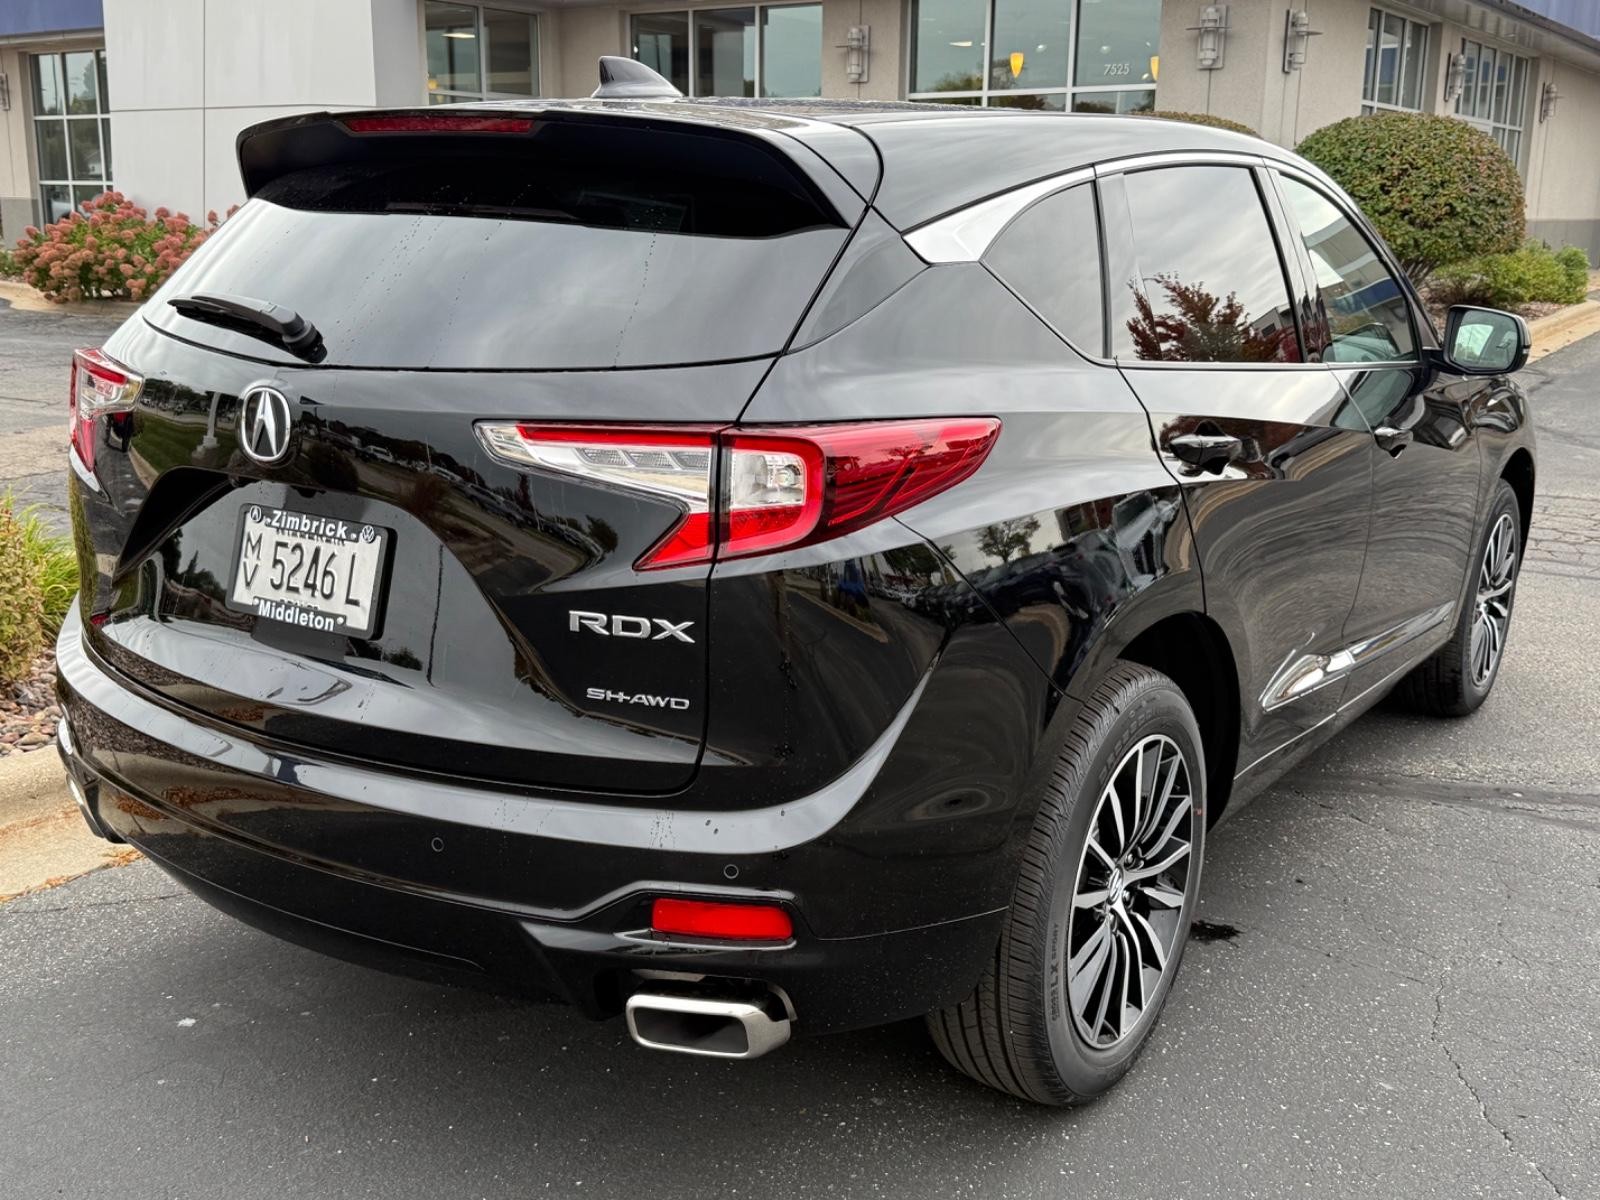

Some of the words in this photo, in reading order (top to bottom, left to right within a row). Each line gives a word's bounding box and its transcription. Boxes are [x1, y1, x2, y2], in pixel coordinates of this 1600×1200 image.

[1104, 63, 1130, 76] 7525
[271, 510, 348, 539] Zimbrick
[270, 540, 338, 600] 5246
[345, 552, 361, 607] L
[258, 600, 335, 632] Middleton
[568, 610, 695, 644] RDX
[586, 687, 690, 710] SH-AWD
